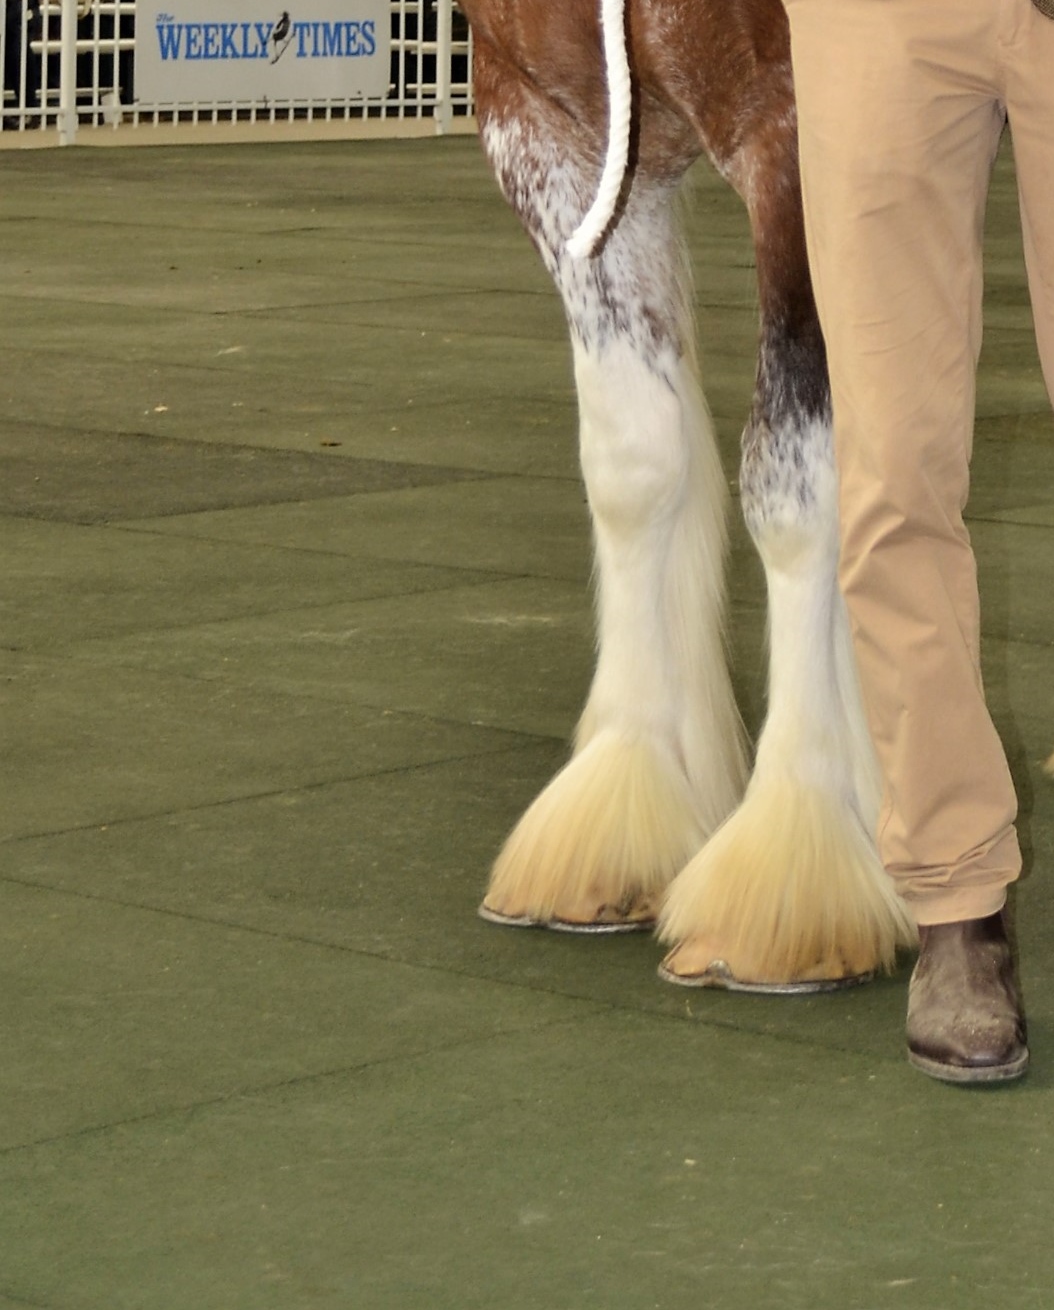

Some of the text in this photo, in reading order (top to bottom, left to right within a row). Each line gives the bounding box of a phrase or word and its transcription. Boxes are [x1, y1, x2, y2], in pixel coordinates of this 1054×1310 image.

[156, 13, 175, 22] The
[156, 21, 376, 60] WEEKLY TIMES
